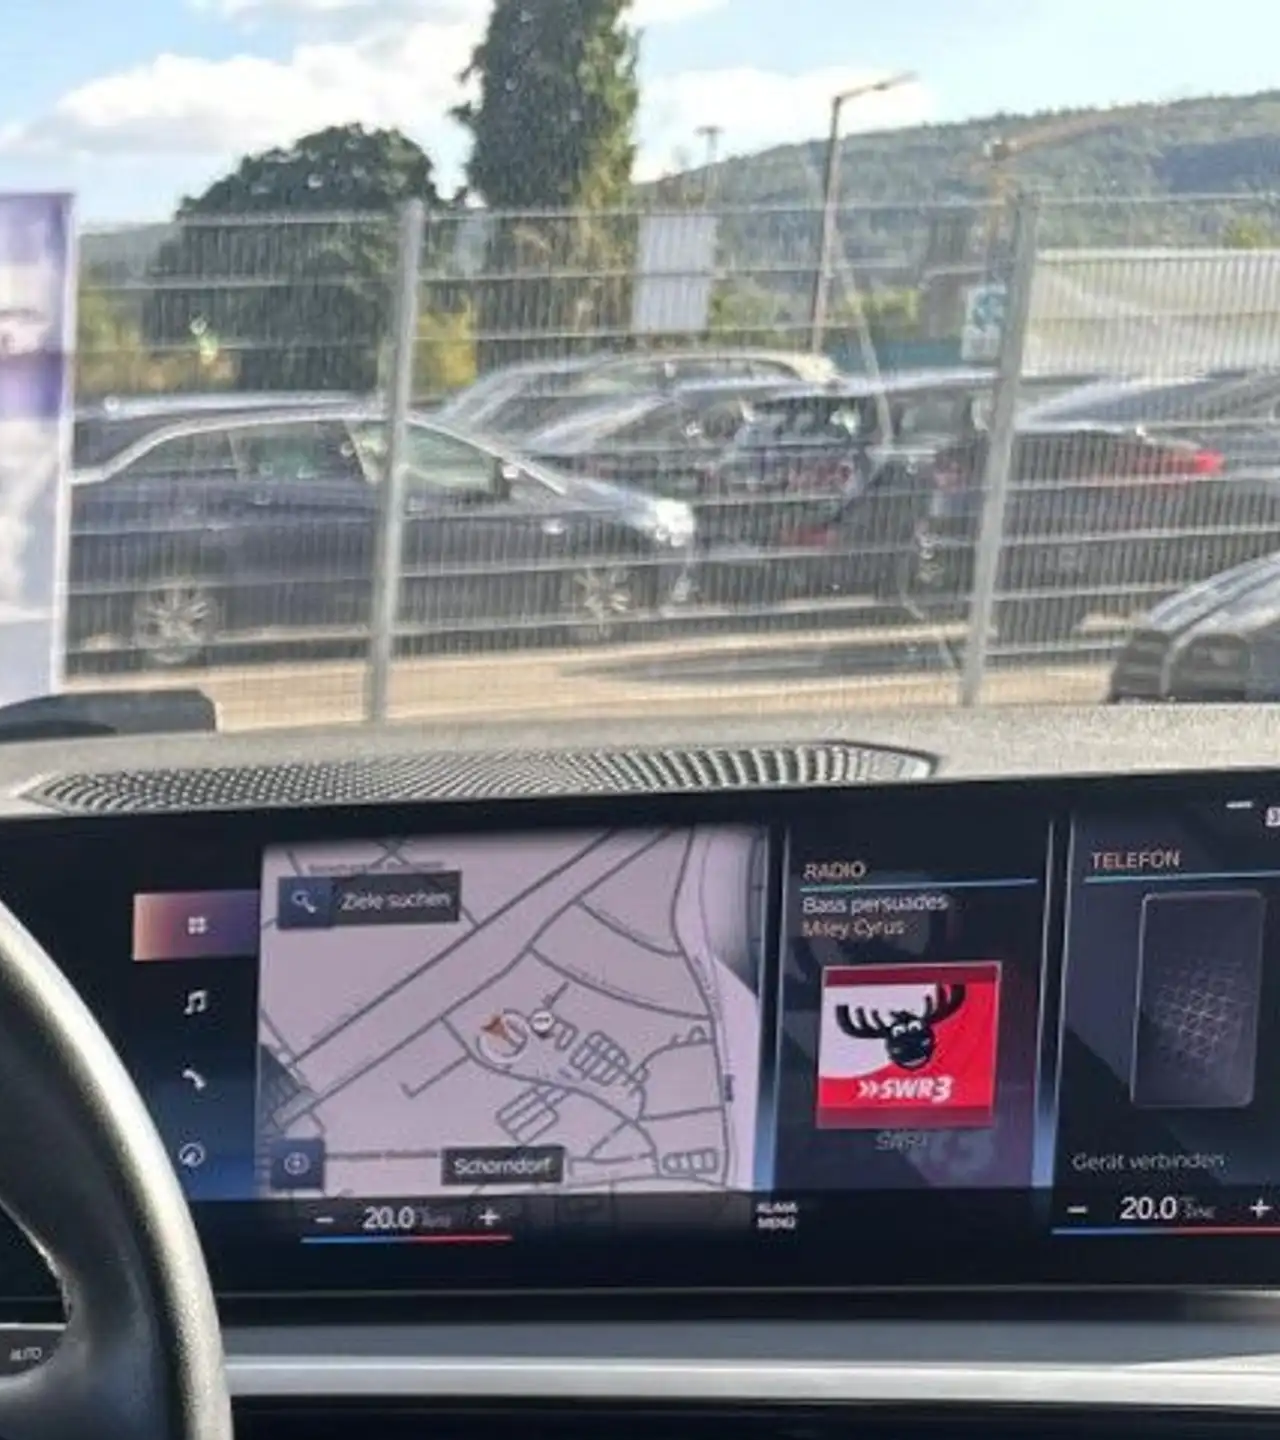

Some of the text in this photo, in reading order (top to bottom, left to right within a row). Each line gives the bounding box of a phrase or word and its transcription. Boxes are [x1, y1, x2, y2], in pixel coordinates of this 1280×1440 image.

[1092, 849, 1181, 869] TELEFON
[803, 861, 866, 880] RADIO
[342, 889, 451, 910] Ziele suchen
[802, 894, 949, 916] Bass persuades
[802, 918, 905, 939] Miley Cyrus
[453, 1156, 554, 1176] Schorndorf
[1072, 1152, 1225, 1171] Gerät verbinden
[362, 1206, 416, 1229] 20.0
[755, 1202, 798, 1214] KLIMA
[1119, 1196, 1178, 1220] 20.0
[8, 1346, 43, 1362] AUTO
